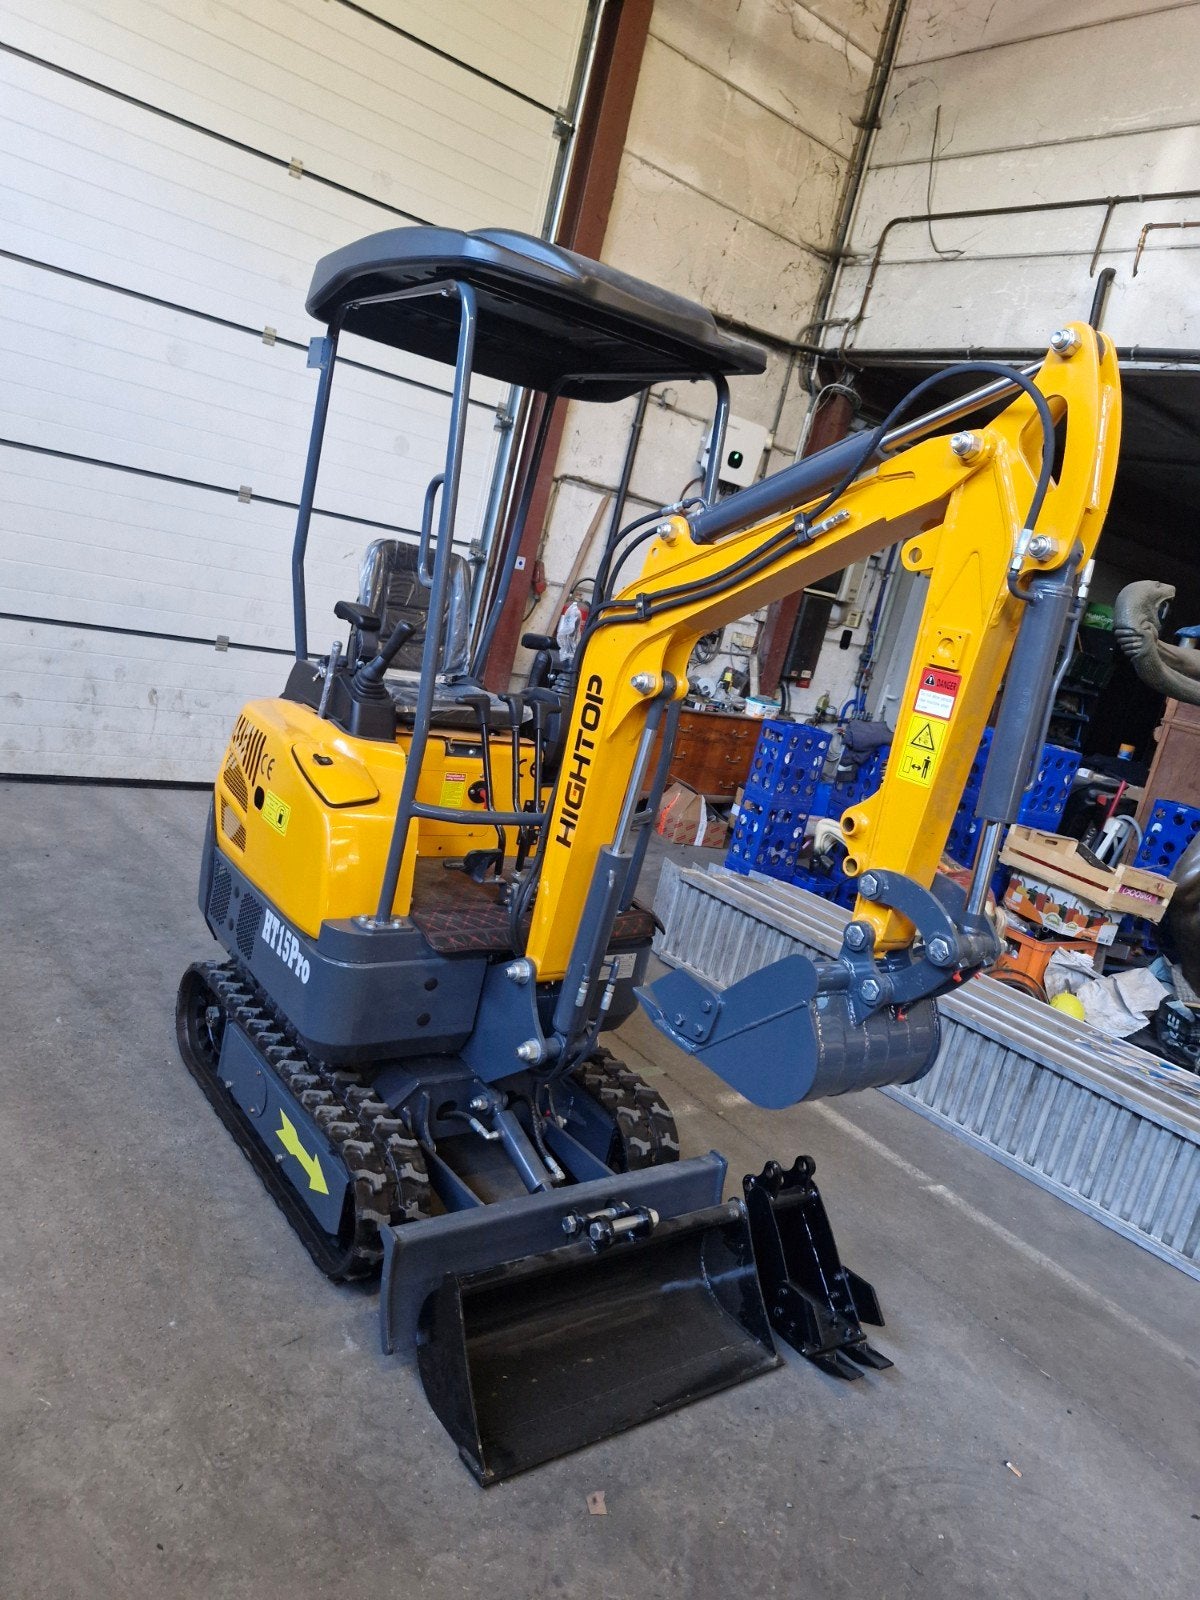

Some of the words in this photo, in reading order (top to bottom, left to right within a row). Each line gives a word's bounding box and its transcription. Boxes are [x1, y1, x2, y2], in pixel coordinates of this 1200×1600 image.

[936, 678, 957, 691] DANGER
[261, 753, 275, 781] CE
[556, 674, 604, 848] HIGHTOP
[261, 908, 310, 985] HT15Pro
